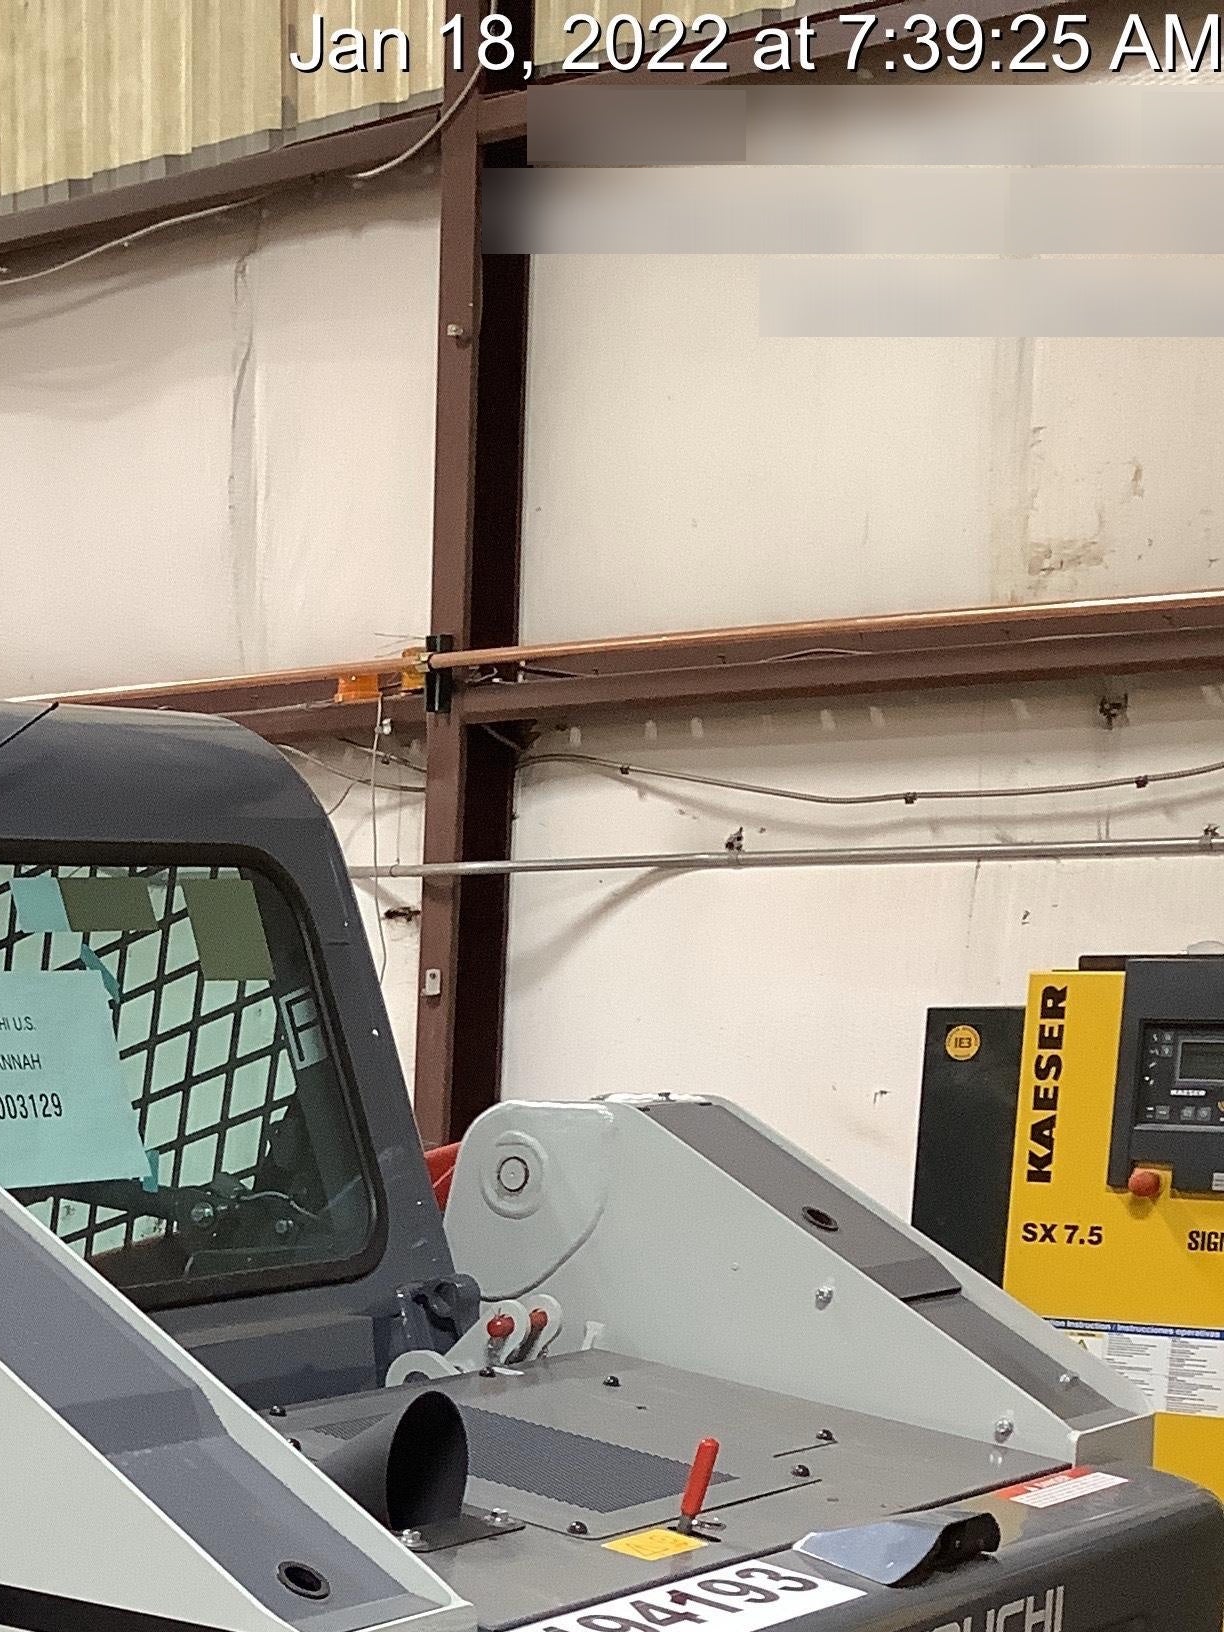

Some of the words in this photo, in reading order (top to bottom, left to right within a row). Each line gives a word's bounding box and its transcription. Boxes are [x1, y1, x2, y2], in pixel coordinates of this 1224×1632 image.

[12, 1016, 37, 1032] U.S.
[1025, 985, 1068, 1185] KAESER
[1021, 1222, 1058, 1244] SX
[1063, 1224, 1104, 1246] 7.5
